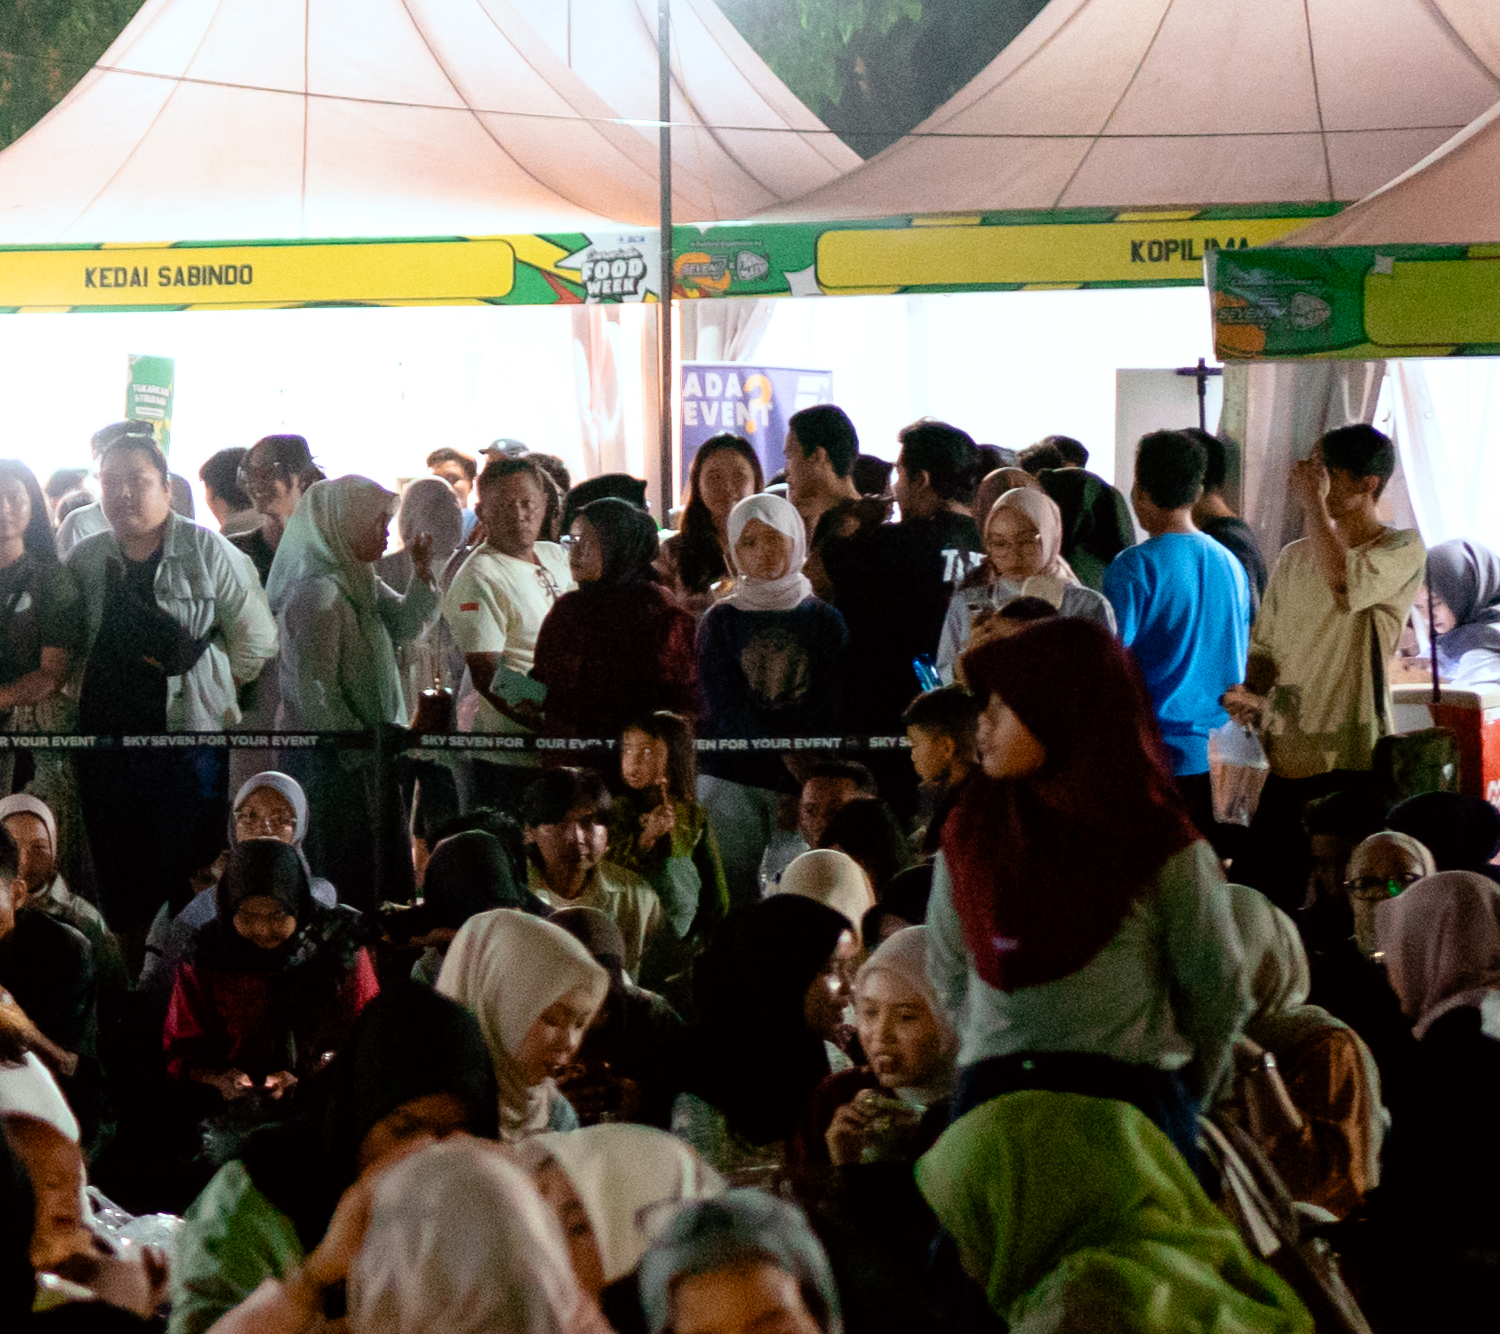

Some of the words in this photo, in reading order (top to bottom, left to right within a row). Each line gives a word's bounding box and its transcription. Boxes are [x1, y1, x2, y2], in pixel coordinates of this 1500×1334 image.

[85, 266, 149, 288] KEDAI
[158, 264, 253, 287] SABINDO
[581, 258, 644, 283] FOOD
[585, 277, 636, 294] WEEK
[682, 372, 743, 397] ADA
[683, 400, 773, 427] EVENT
[11, 736, 49, 747] YOUR
[51, 736, 97, 747] EVENT
[123, 736, 150, 747] SKY
[151, 736, 195, 746] SEVEN
[198, 735, 227, 746] FOR
[229, 735, 269, 745] YOUR
[271, 735, 319, 745] EVENT
[421, 735, 447, 746] SKY
[449, 736, 494, 747] SEVEN
[496, 737, 524, 748] FOR
[535, 738, 566, 748] OUR
[719, 739, 748, 750] FOR
[751, 738, 791, 749] YOUR
[794, 737, 843, 748] EVENT
[869, 737, 897, 748] SKY
